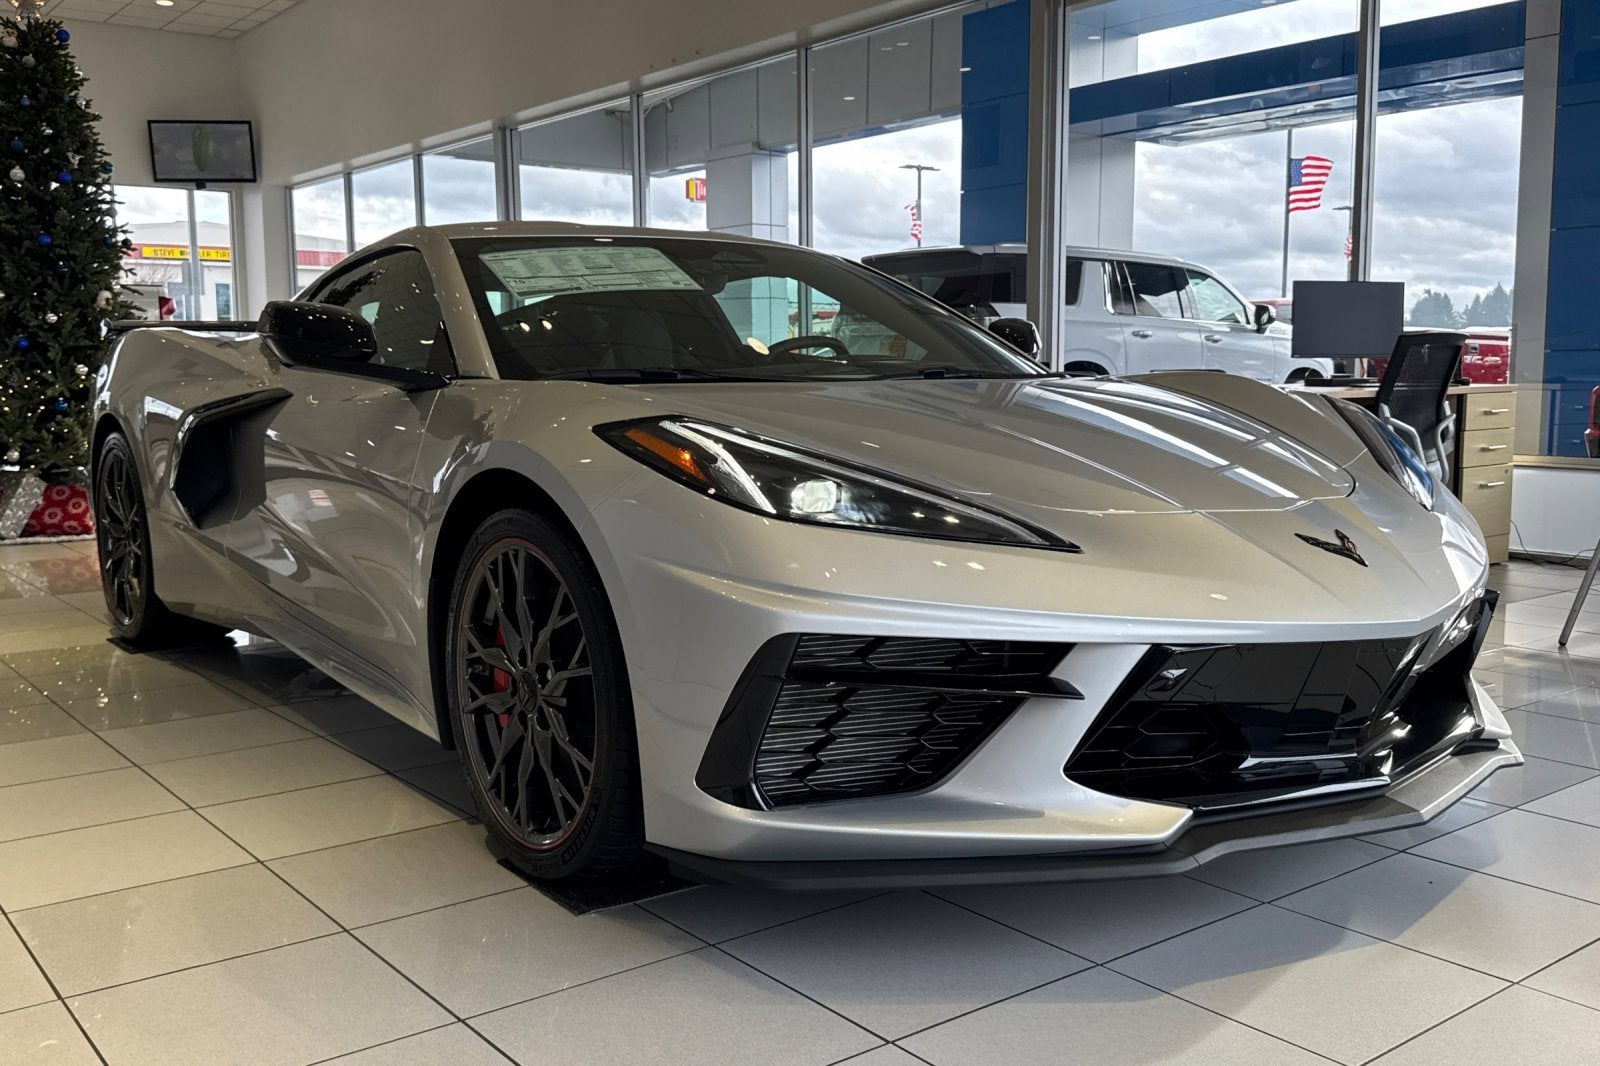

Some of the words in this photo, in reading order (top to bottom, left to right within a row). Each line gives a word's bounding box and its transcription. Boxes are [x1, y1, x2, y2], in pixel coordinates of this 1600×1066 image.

[153, 249, 175, 257] STEVE
[180, 249, 212, 258] WHLER
[561, 806, 597, 860] MICHELIN
